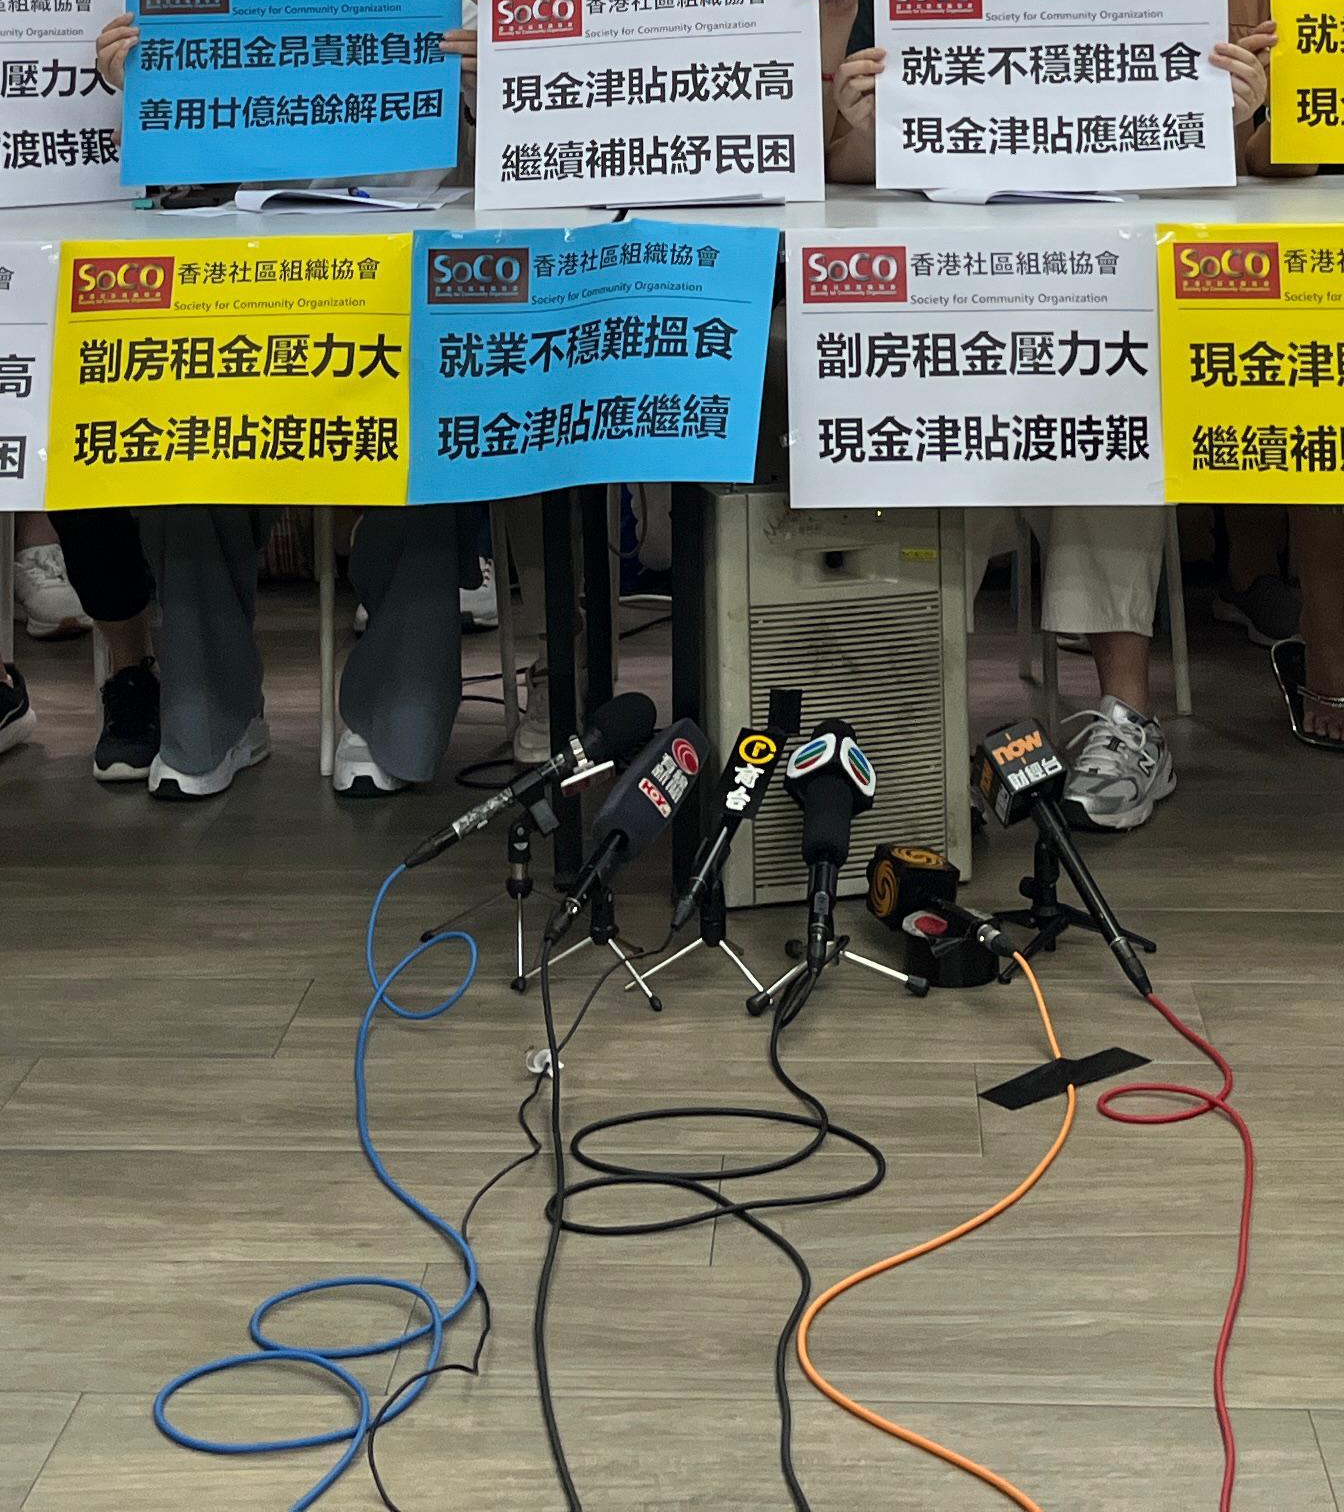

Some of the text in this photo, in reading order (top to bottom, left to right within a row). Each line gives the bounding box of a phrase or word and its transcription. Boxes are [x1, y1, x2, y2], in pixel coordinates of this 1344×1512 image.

[985, 9, 1163, 22] Society for Community Organization
[140, 32, 445, 71] 薪低租金昂貴難負擔
[901, 41, 1202, 86] 就業不穩難搵食
[140, 89, 443, 130] 善用廿億結餘解民困
[502, 61, 795, 114] 現金津貼成效高
[902, 112, 1206, 155] 現金津貼應繼續
[501, 133, 796, 182] 繼續補貼紓民困
[177, 257, 380, 286] 香港社區組織協會
[533, 242, 720, 279] 香港社區組織協會
[910, 250, 1118, 277] 香港社區組織協會
[910, 292, 1108, 306] Society for Community Organization
[79, 333, 402, 387] 劏房租金壓力大
[439, 316, 738, 380] 就業不穩難搵食
[817, 331, 1149, 380] 劏房租金壓力大
[74, 414, 399, 465] 現金津貼渡時艱
[438, 394, 730, 461] 現金津貼應繼續
[819, 414, 1149, 462] 現金津貼渡時艱
